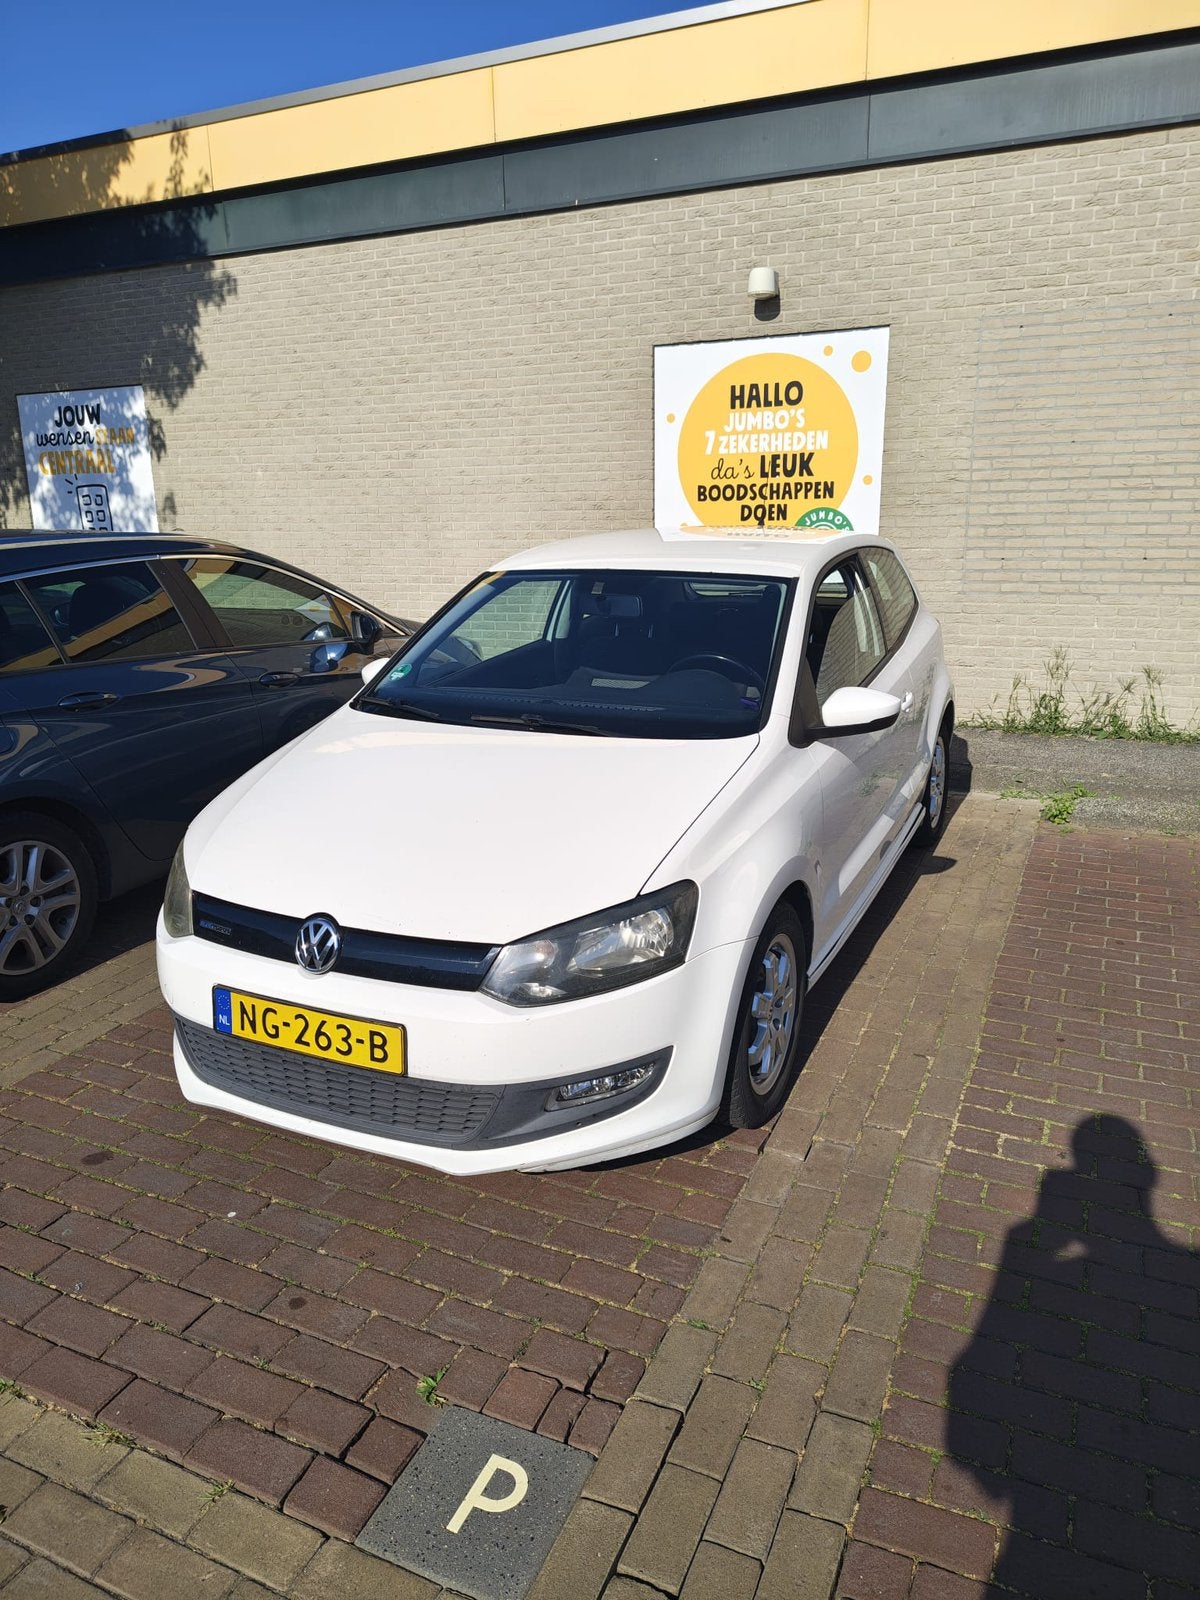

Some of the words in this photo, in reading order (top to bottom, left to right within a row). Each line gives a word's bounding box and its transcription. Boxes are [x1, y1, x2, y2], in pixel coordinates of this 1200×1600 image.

[730, 380, 804, 410] HALLO
[54, 403, 101, 428] JOUW
[723, 408, 805, 432] JUMBO'S
[36, 430, 94, 447] wensen
[95, 427, 135, 446] STAAN
[704, 430, 716, 455] 7
[718, 430, 829, 454] ZEKERHEDEN
[38, 448, 116, 476] CENTRAAL
[710, 458, 755, 480] da's
[760, 452, 815, 479] LEUK
[697, 481, 835, 502] BOODSCHAPPEN
[740, 504, 788, 522] DOEN
[219, 1013, 231, 1026] NL
[239, 1000, 389, 1063] NG-263-B
[446, 1453, 529, 1534] P
